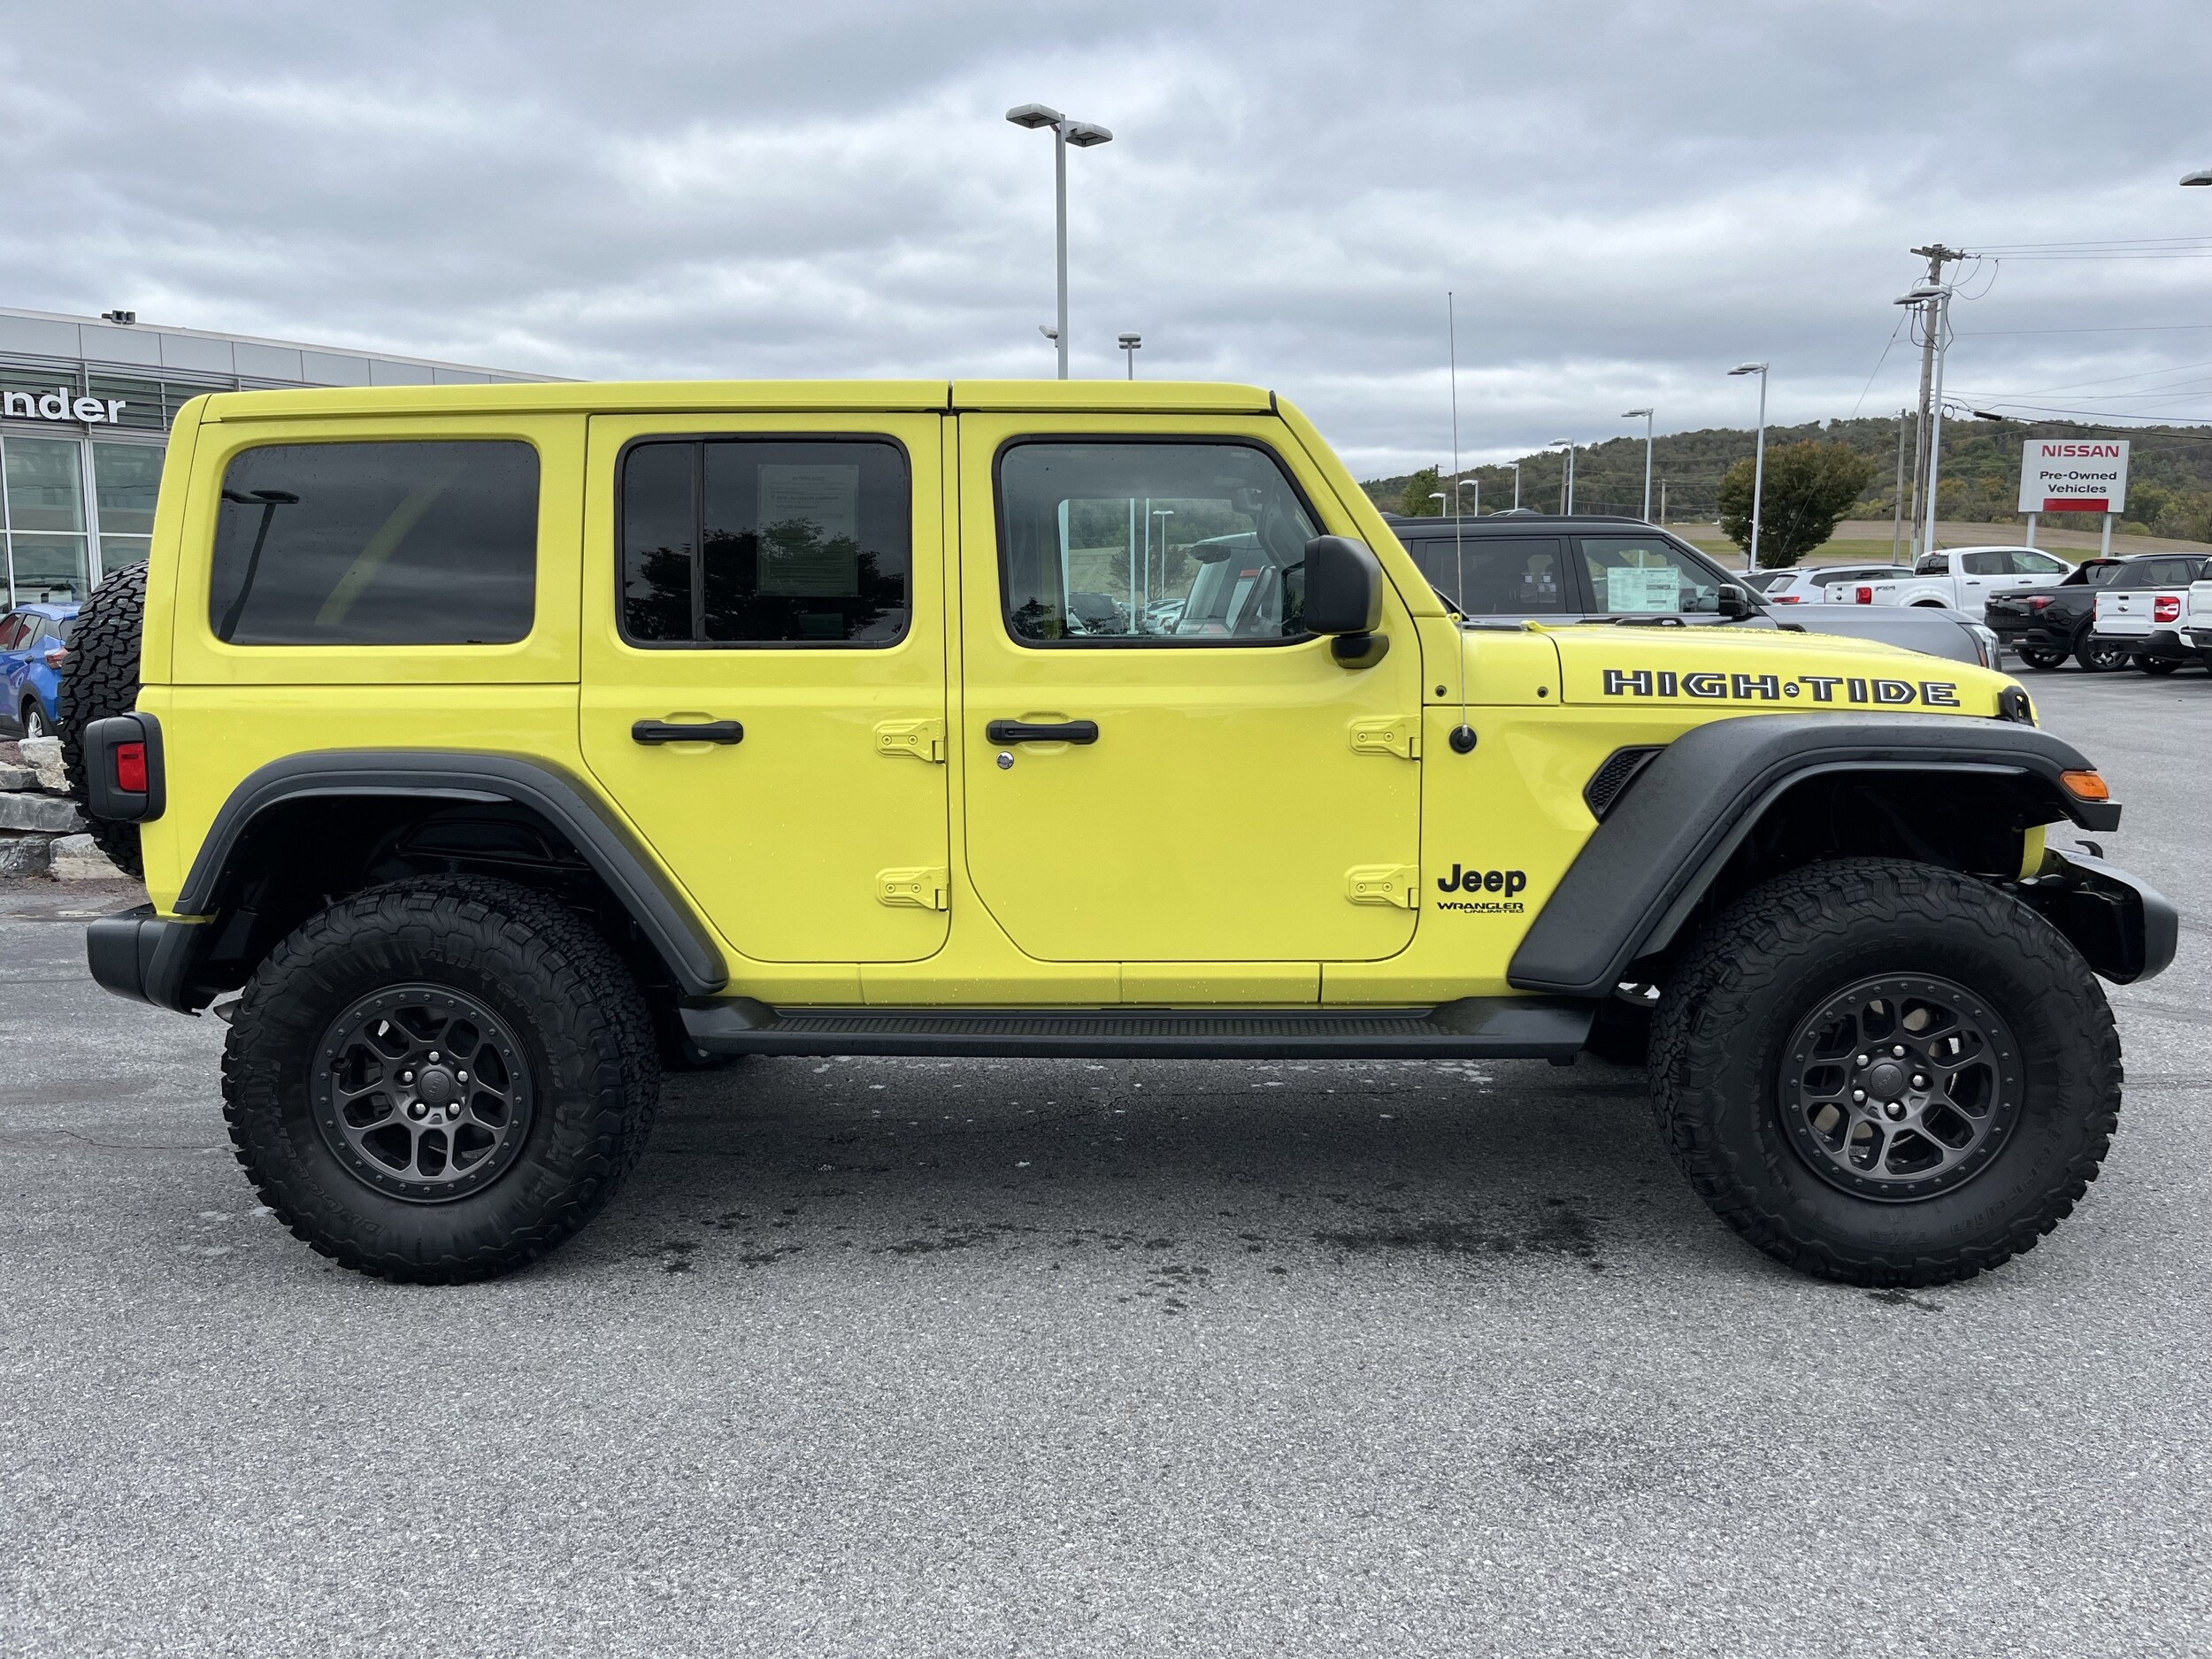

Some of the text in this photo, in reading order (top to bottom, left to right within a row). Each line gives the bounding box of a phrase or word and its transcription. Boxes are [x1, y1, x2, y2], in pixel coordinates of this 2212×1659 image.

[4, 387, 127, 424] nder
[2041, 445, 2120, 457] NISSAN
[2039, 471, 2117, 480] Pre-Owned
[2048, 484, 2107, 494] Vehicles
[1437, 864, 1527, 898] Jeep
